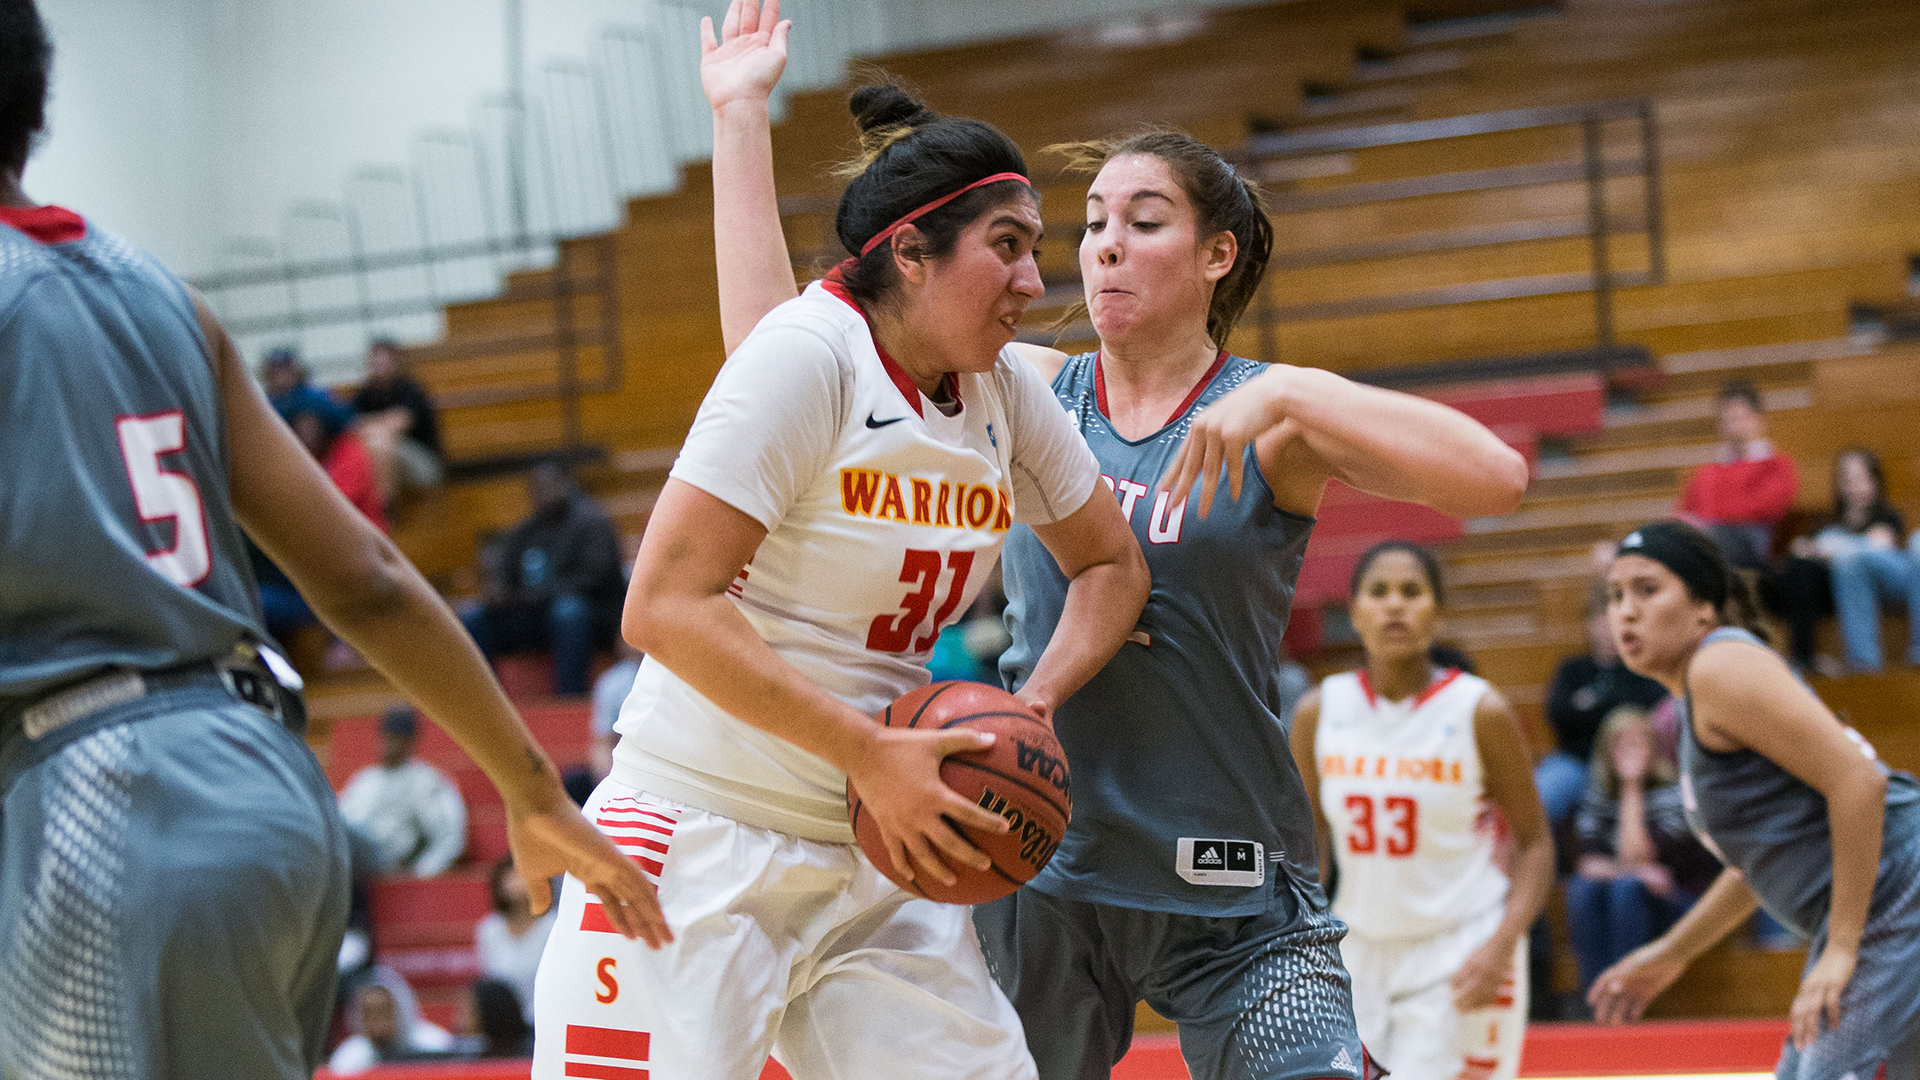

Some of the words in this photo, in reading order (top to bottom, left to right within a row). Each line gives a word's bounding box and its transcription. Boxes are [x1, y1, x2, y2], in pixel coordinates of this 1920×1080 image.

[113, 408, 214, 589] 5
[1100, 473, 1187, 545] TU
[866, 548, 975, 653] 31
[1237, 851, 1246, 861] M
[1344, 795, 1418, 857] 33
[594, 956, 619, 1005] S
